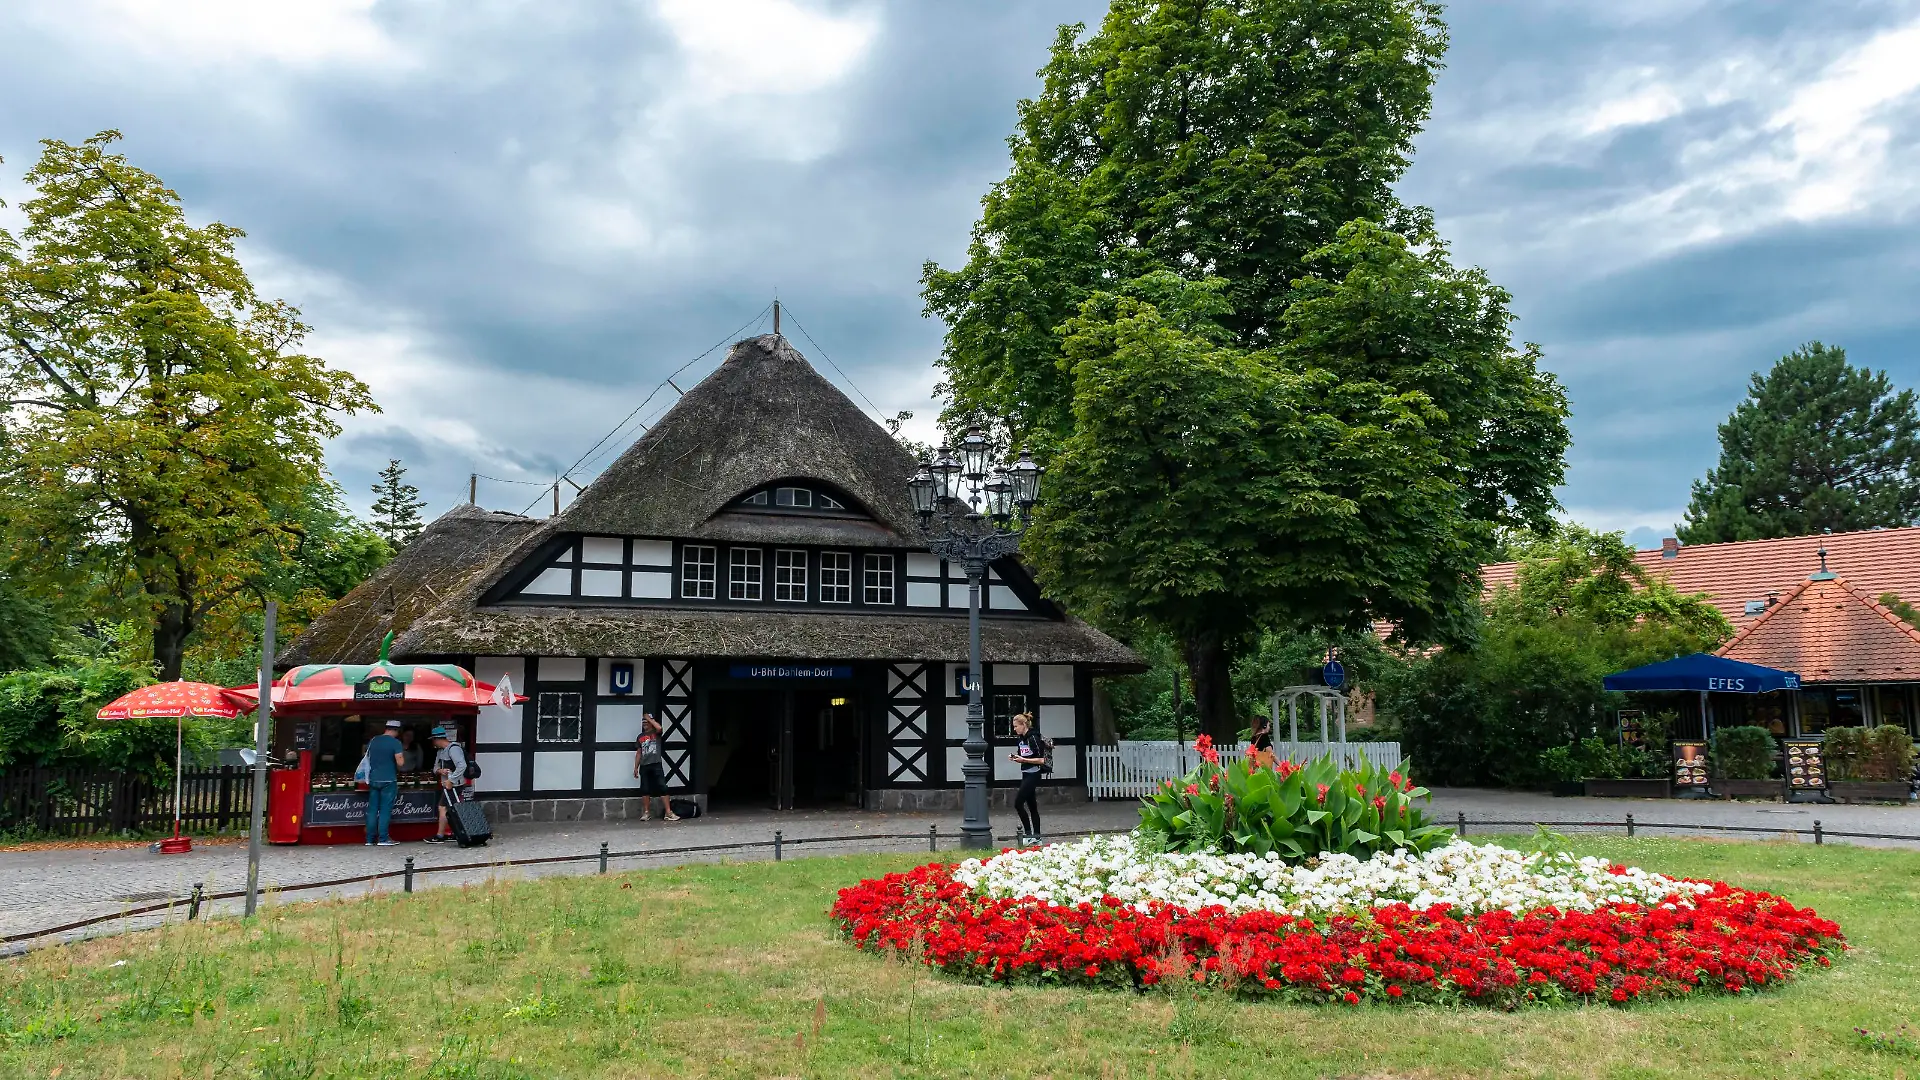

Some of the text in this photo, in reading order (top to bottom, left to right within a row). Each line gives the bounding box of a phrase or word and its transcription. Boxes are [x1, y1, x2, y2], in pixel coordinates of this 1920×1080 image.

[751, 667, 834, 677] U-Bhf Dahlem-Dorf
[615, 671, 630, 688] U
[1708, 677, 1745, 691] EFES
[315, 798, 351, 811] Frisch
[345, 811, 364, 819] aus
[403, 803, 433, 815] Ernte
